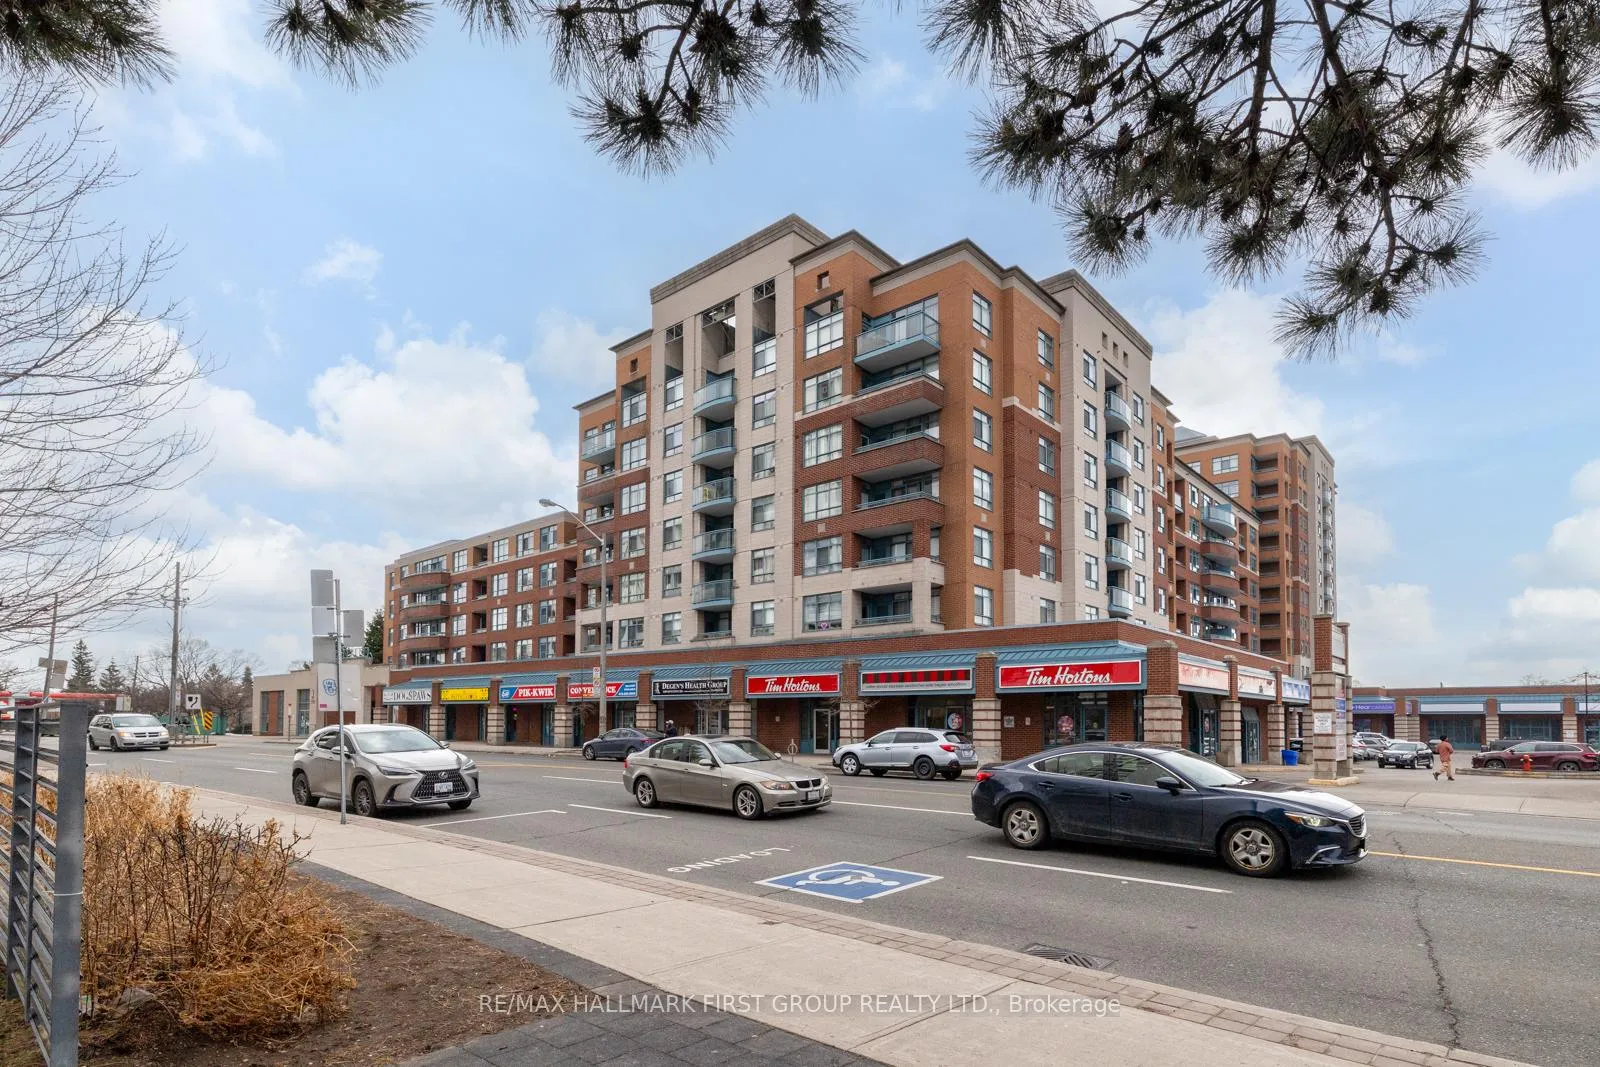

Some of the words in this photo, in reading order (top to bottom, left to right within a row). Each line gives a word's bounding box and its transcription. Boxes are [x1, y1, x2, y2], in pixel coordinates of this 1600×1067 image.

[1026, 667, 1051, 685] Tim
[1054, 666, 1111, 685] Hortons
[570, 685, 616, 695] CONVECE
[684, 681, 707, 689] HEALTH
[765, 678, 782, 692] Tim
[783, 677, 820, 692] Hortons
[667, 847, 791, 873] LOADING
